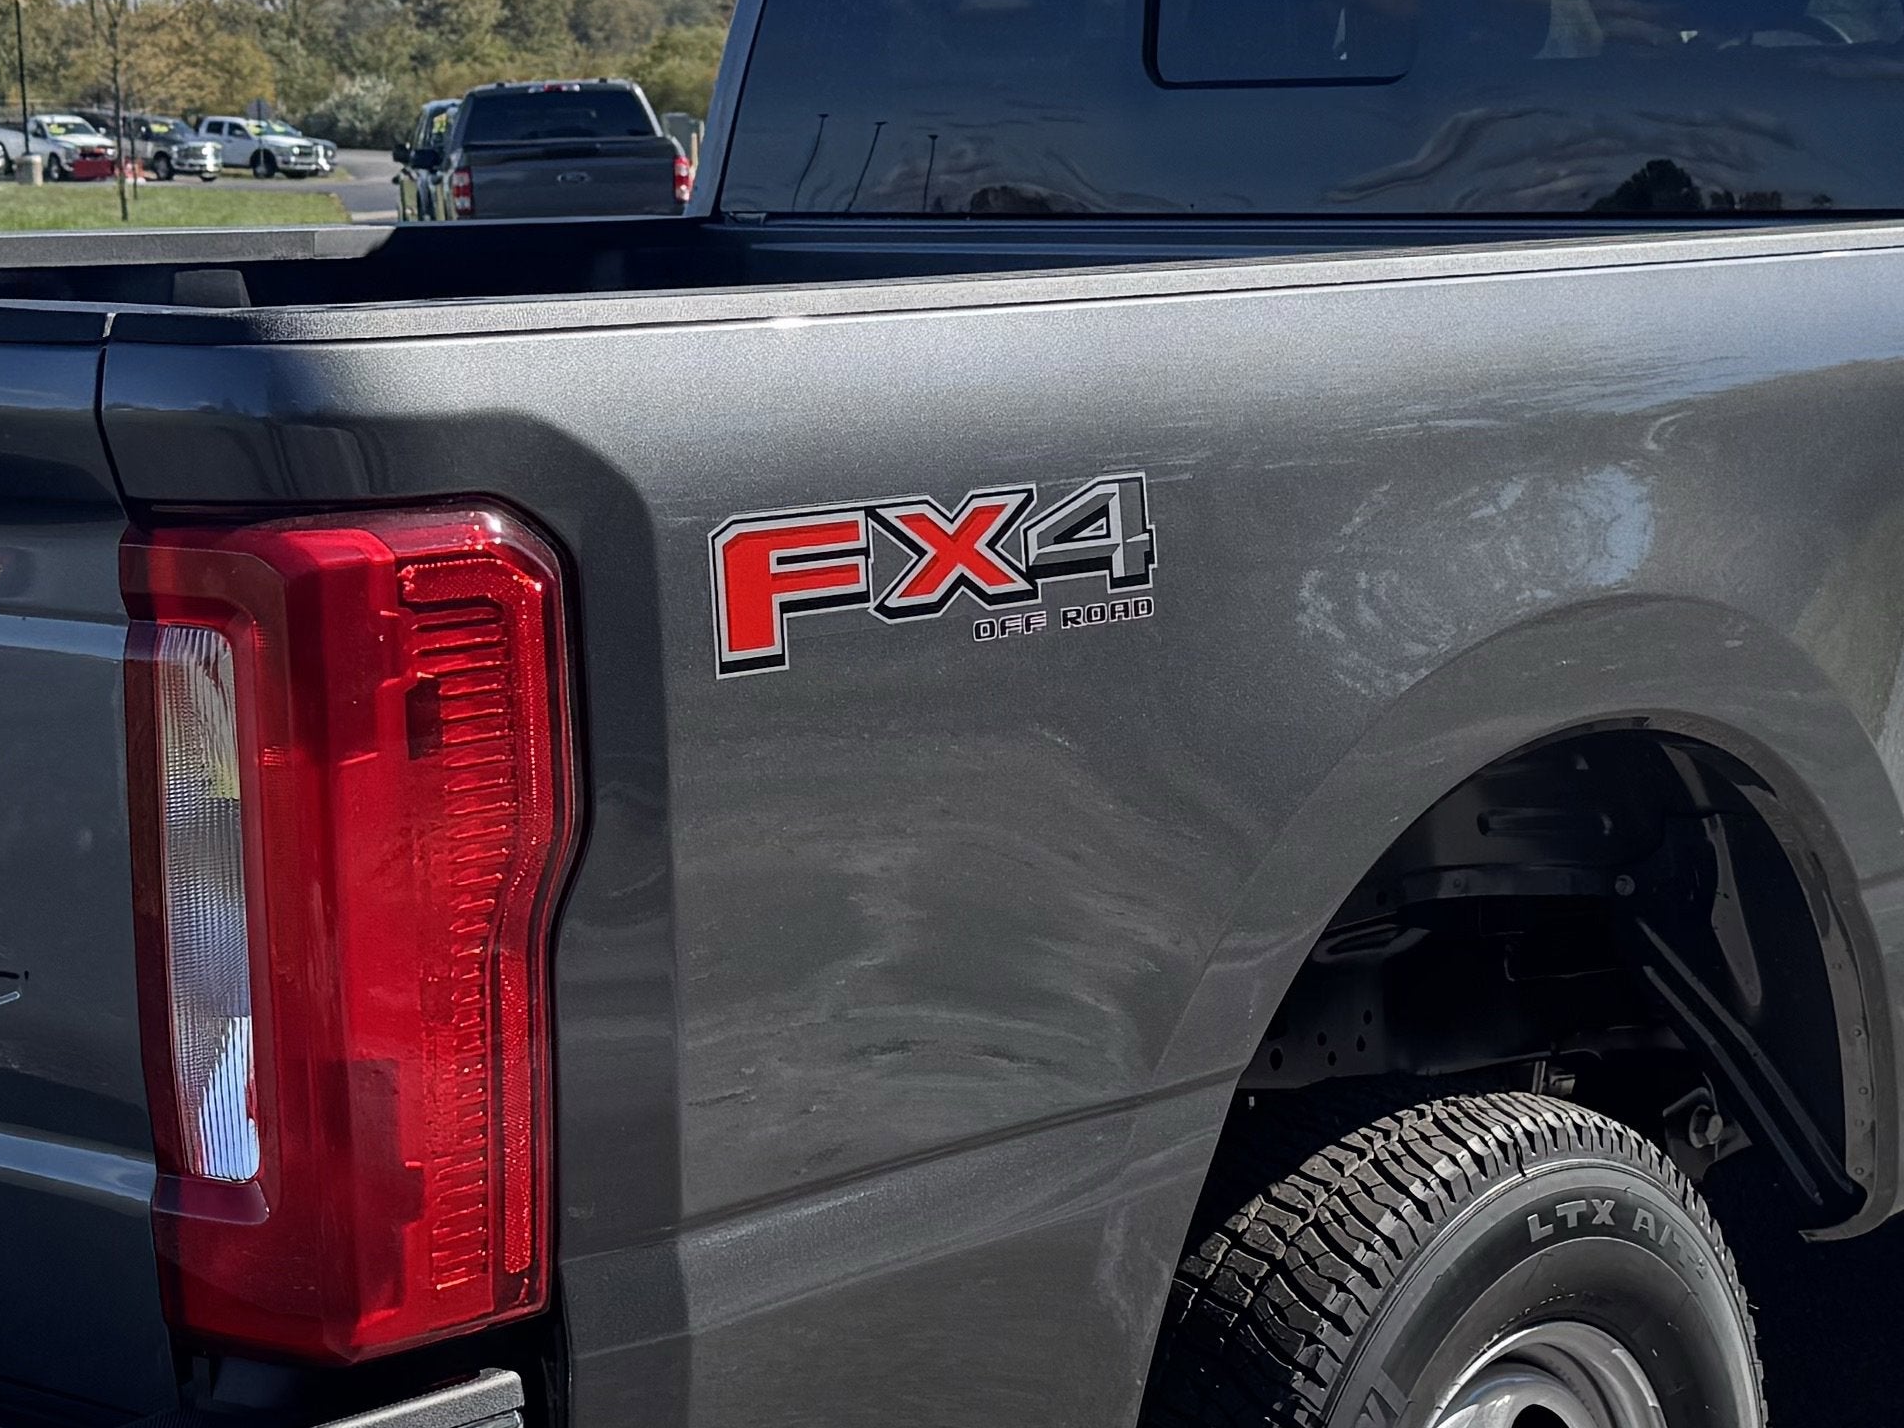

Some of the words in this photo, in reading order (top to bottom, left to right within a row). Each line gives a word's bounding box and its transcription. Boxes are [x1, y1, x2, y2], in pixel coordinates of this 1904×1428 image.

[707, 470, 1159, 679] FX4
[972, 610, 1048, 643] OFF
[1060, 594, 1155, 630] ROAD
[1526, 1198, 1617, 1243] LTX
